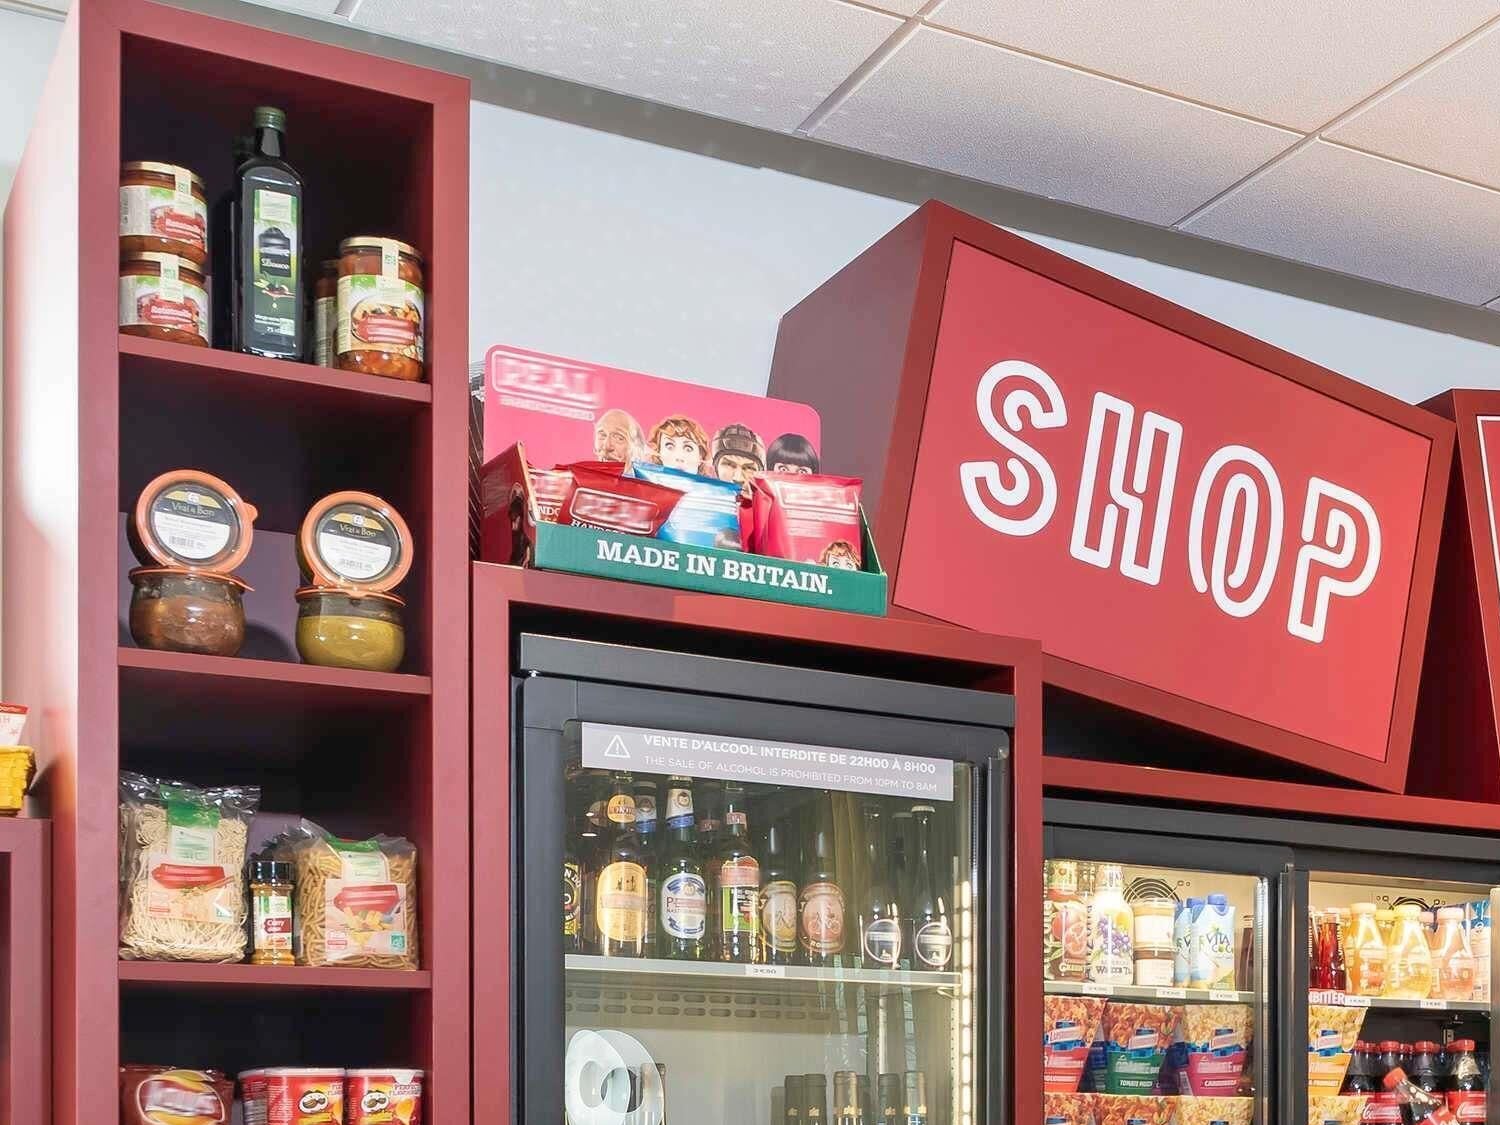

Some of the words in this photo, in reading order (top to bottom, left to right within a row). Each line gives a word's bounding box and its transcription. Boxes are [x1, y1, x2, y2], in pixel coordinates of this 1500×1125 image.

[959, 359, 1383, 645] SHOP
[596, 539, 680, 571] MADE
[685, 553, 716, 579] IN
[721, 556, 834, 595] BRITAIN.
[644, 734, 689, 750] VENTE
[691, 739, 757, 756] D'ALCOOL
[760, 746, 827, 763] INTERDITE
[830, 753, 847, 765] DE
[849, 755, 890, 769] 22H00
[892, 756, 901, 771] À
[903, 761, 937, 774] 8H00
[644, 755, 665, 766] THE
[668, 758, 696, 769] SALE
[698, 760, 714, 771] OF
[715, 763, 767, 776] ALCOHOL
[769, 767, 778, 777] IS
[781, 768, 842, 784] PROHIBITED
[844, 775, 873, 785] FROM
[874, 778, 899, 789] 10PM
[901, 781, 914, 790] TO
[916, 782, 938, 792] 8AM
